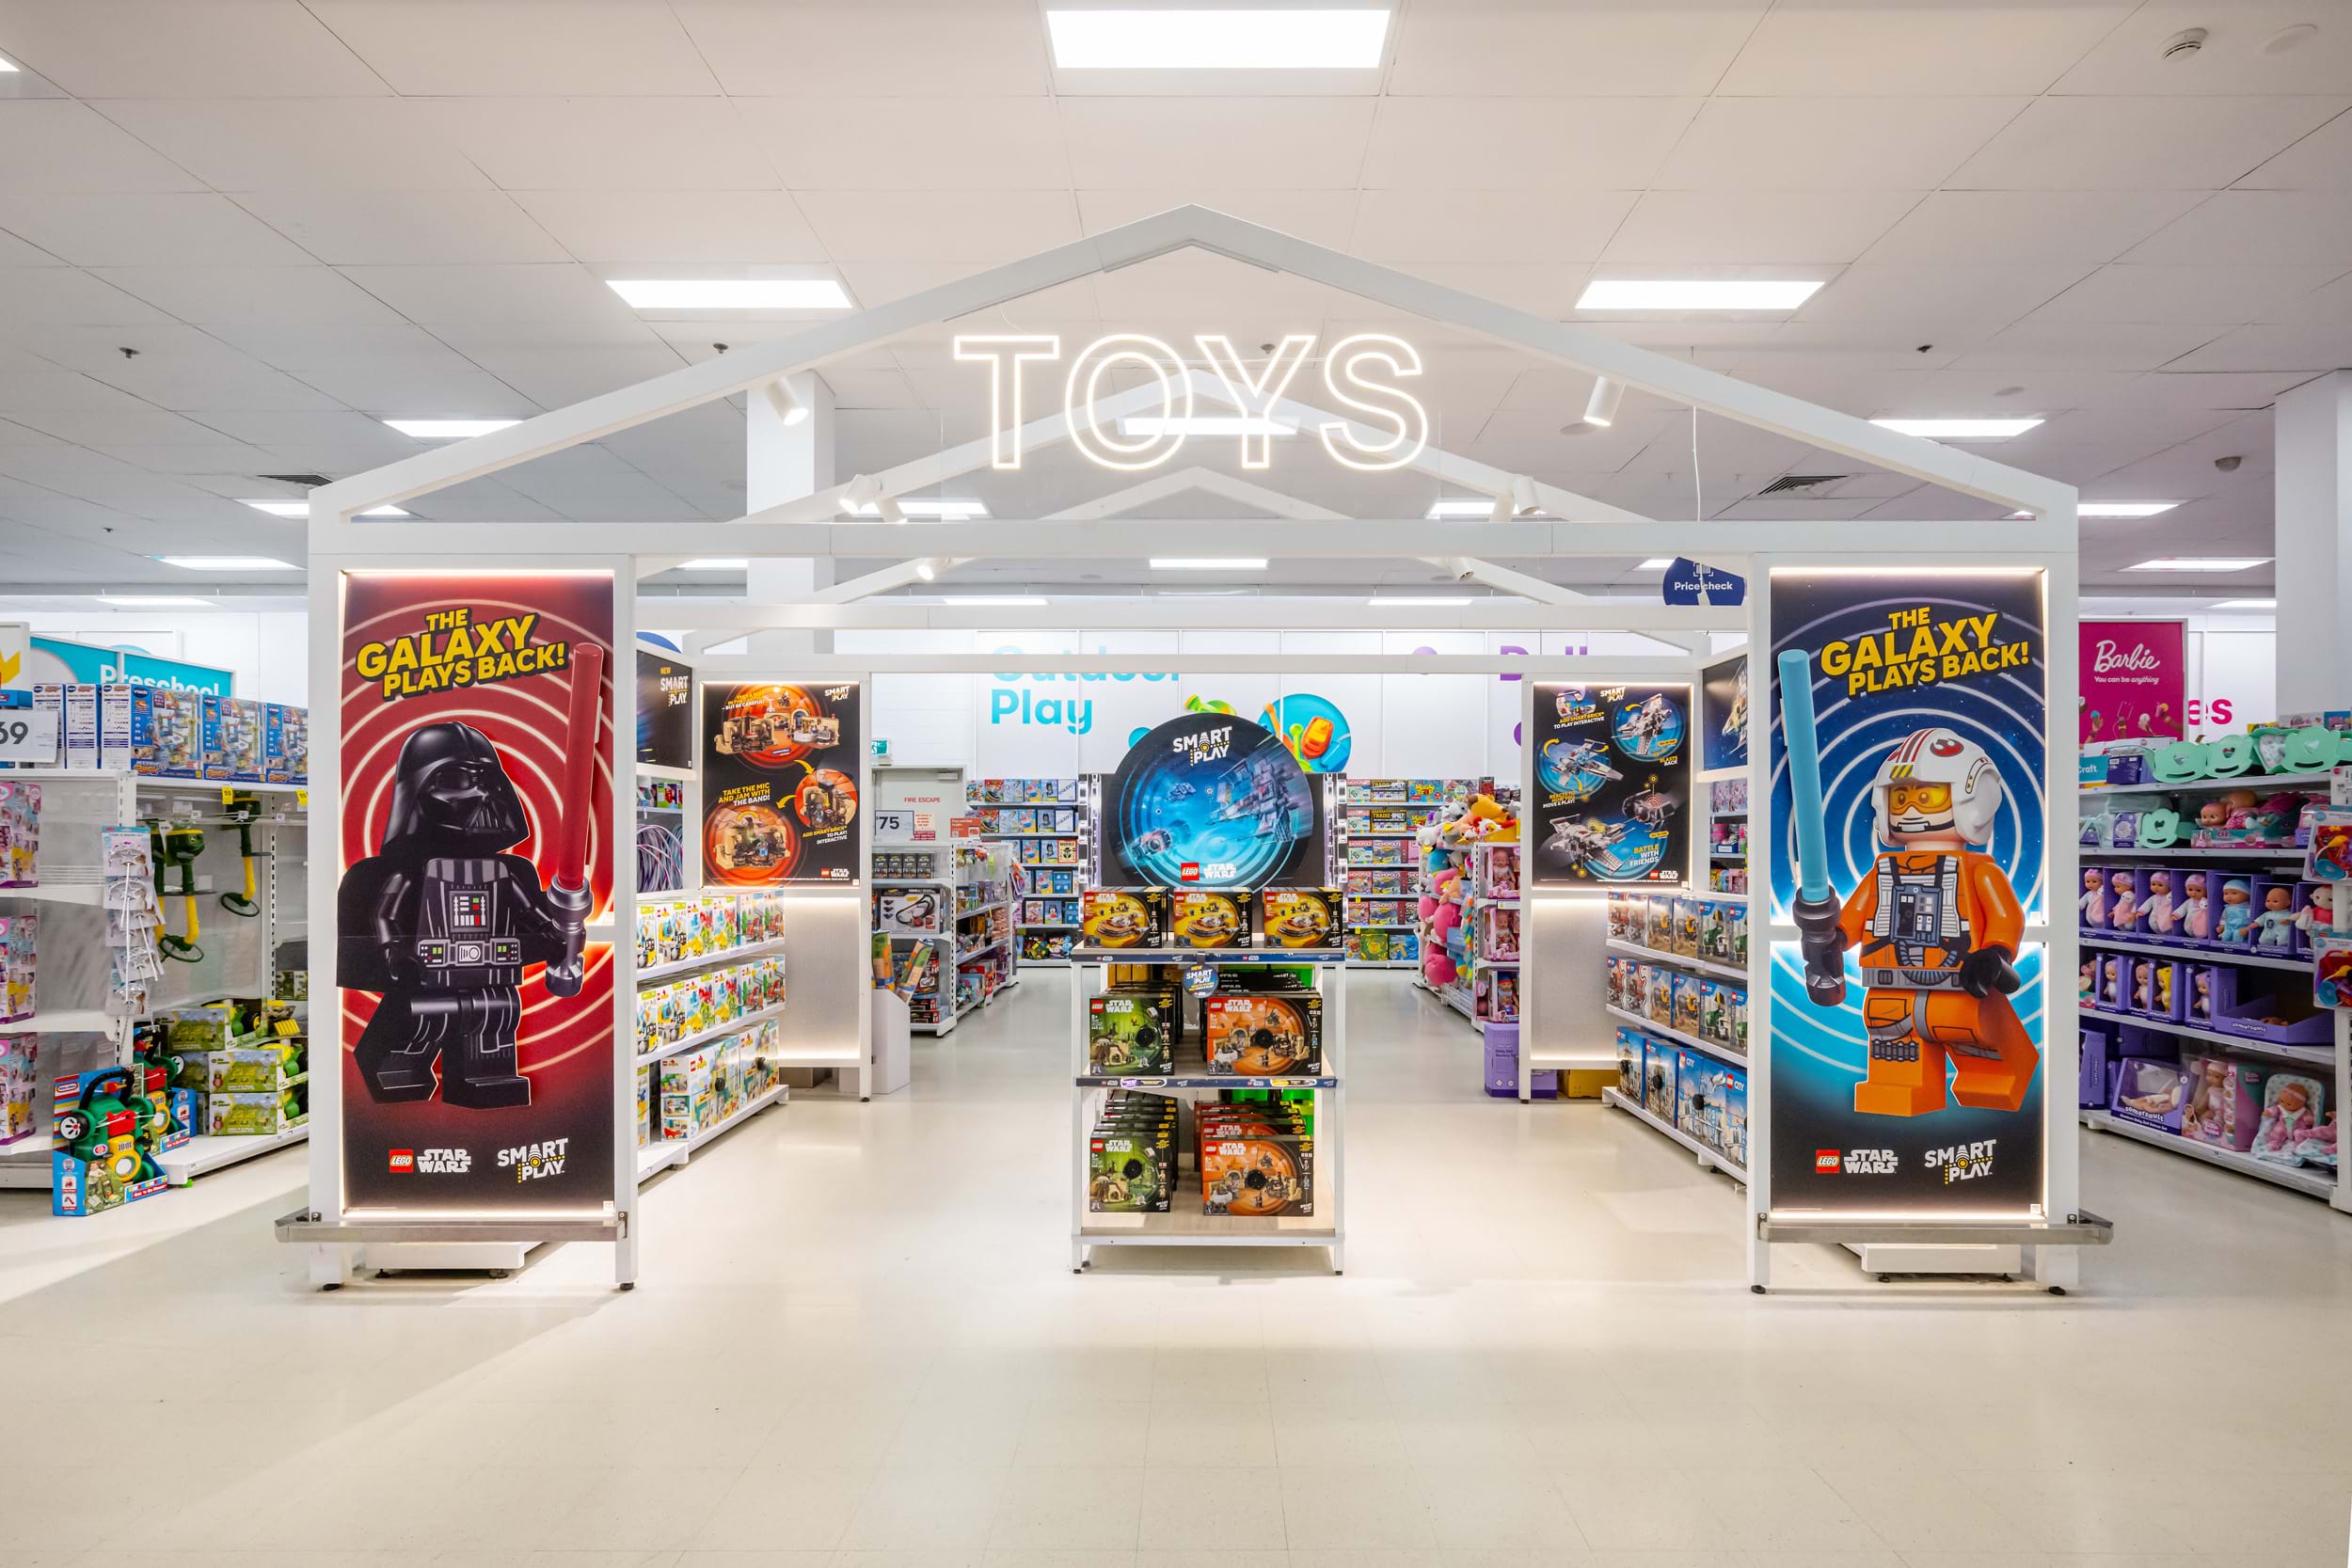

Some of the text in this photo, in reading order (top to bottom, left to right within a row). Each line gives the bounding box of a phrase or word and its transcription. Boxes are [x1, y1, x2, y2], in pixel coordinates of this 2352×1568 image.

[954, 333, 1429, 470] TOYS
[1674, 581, 1733, 591] Price check
[426, 609, 469, 631] THE
[1888, 607, 1931, 630] THE
[357, 614, 535, 677] GALAXY
[1821, 613, 1997, 676] GALAXY
[2094, 640, 2161, 673] Barbie
[383, 642, 565, 697] PLAYS BACK!
[1849, 641, 2029, 696] PLAYS BACK!
[660, 676, 689, 691] SMART
[2131, 676, 2160, 686] anything
[670, 692, 687, 705] PLAY
[824, 686, 850, 697] SMART
[1600, 687, 1626, 697] SMART
[992, 689, 1092, 736] Play
[1573, 716, 1605, 726] INTERACTIVE
[1173, 726, 1232, 752] SMART
[1194, 745, 1229, 766] PLAY
[723, 787, 741, 796] TAKE
[748, 795, 771, 804] BAND!
[1633, 844, 1659, 853] BATTLE
[1640, 849, 1659, 858] WITH
[1203, 863, 1237, 872] STAR
[1629, 857, 1660, 866] FRIENDS
[1182, 867, 1198, 876] LEGO
[1203, 870, 1237, 879] WARS
[1186, 969, 1213, 979] SMART
[2125, 1106, 2164, 1122] somersault
[390, 1148, 471, 1165] LEGO STAR
[497, 1138, 568, 1167] SMART
[1817, 1149, 1899, 1166] LEGO STAR
[1924, 1139, 1996, 1167] SMART
[417, 1161, 471, 1173] WARS
[522, 1159, 565, 1180] PLAY
[1844, 1161, 1899, 1174] WARS
[1948, 1162, 1993, 1182] PLAY
